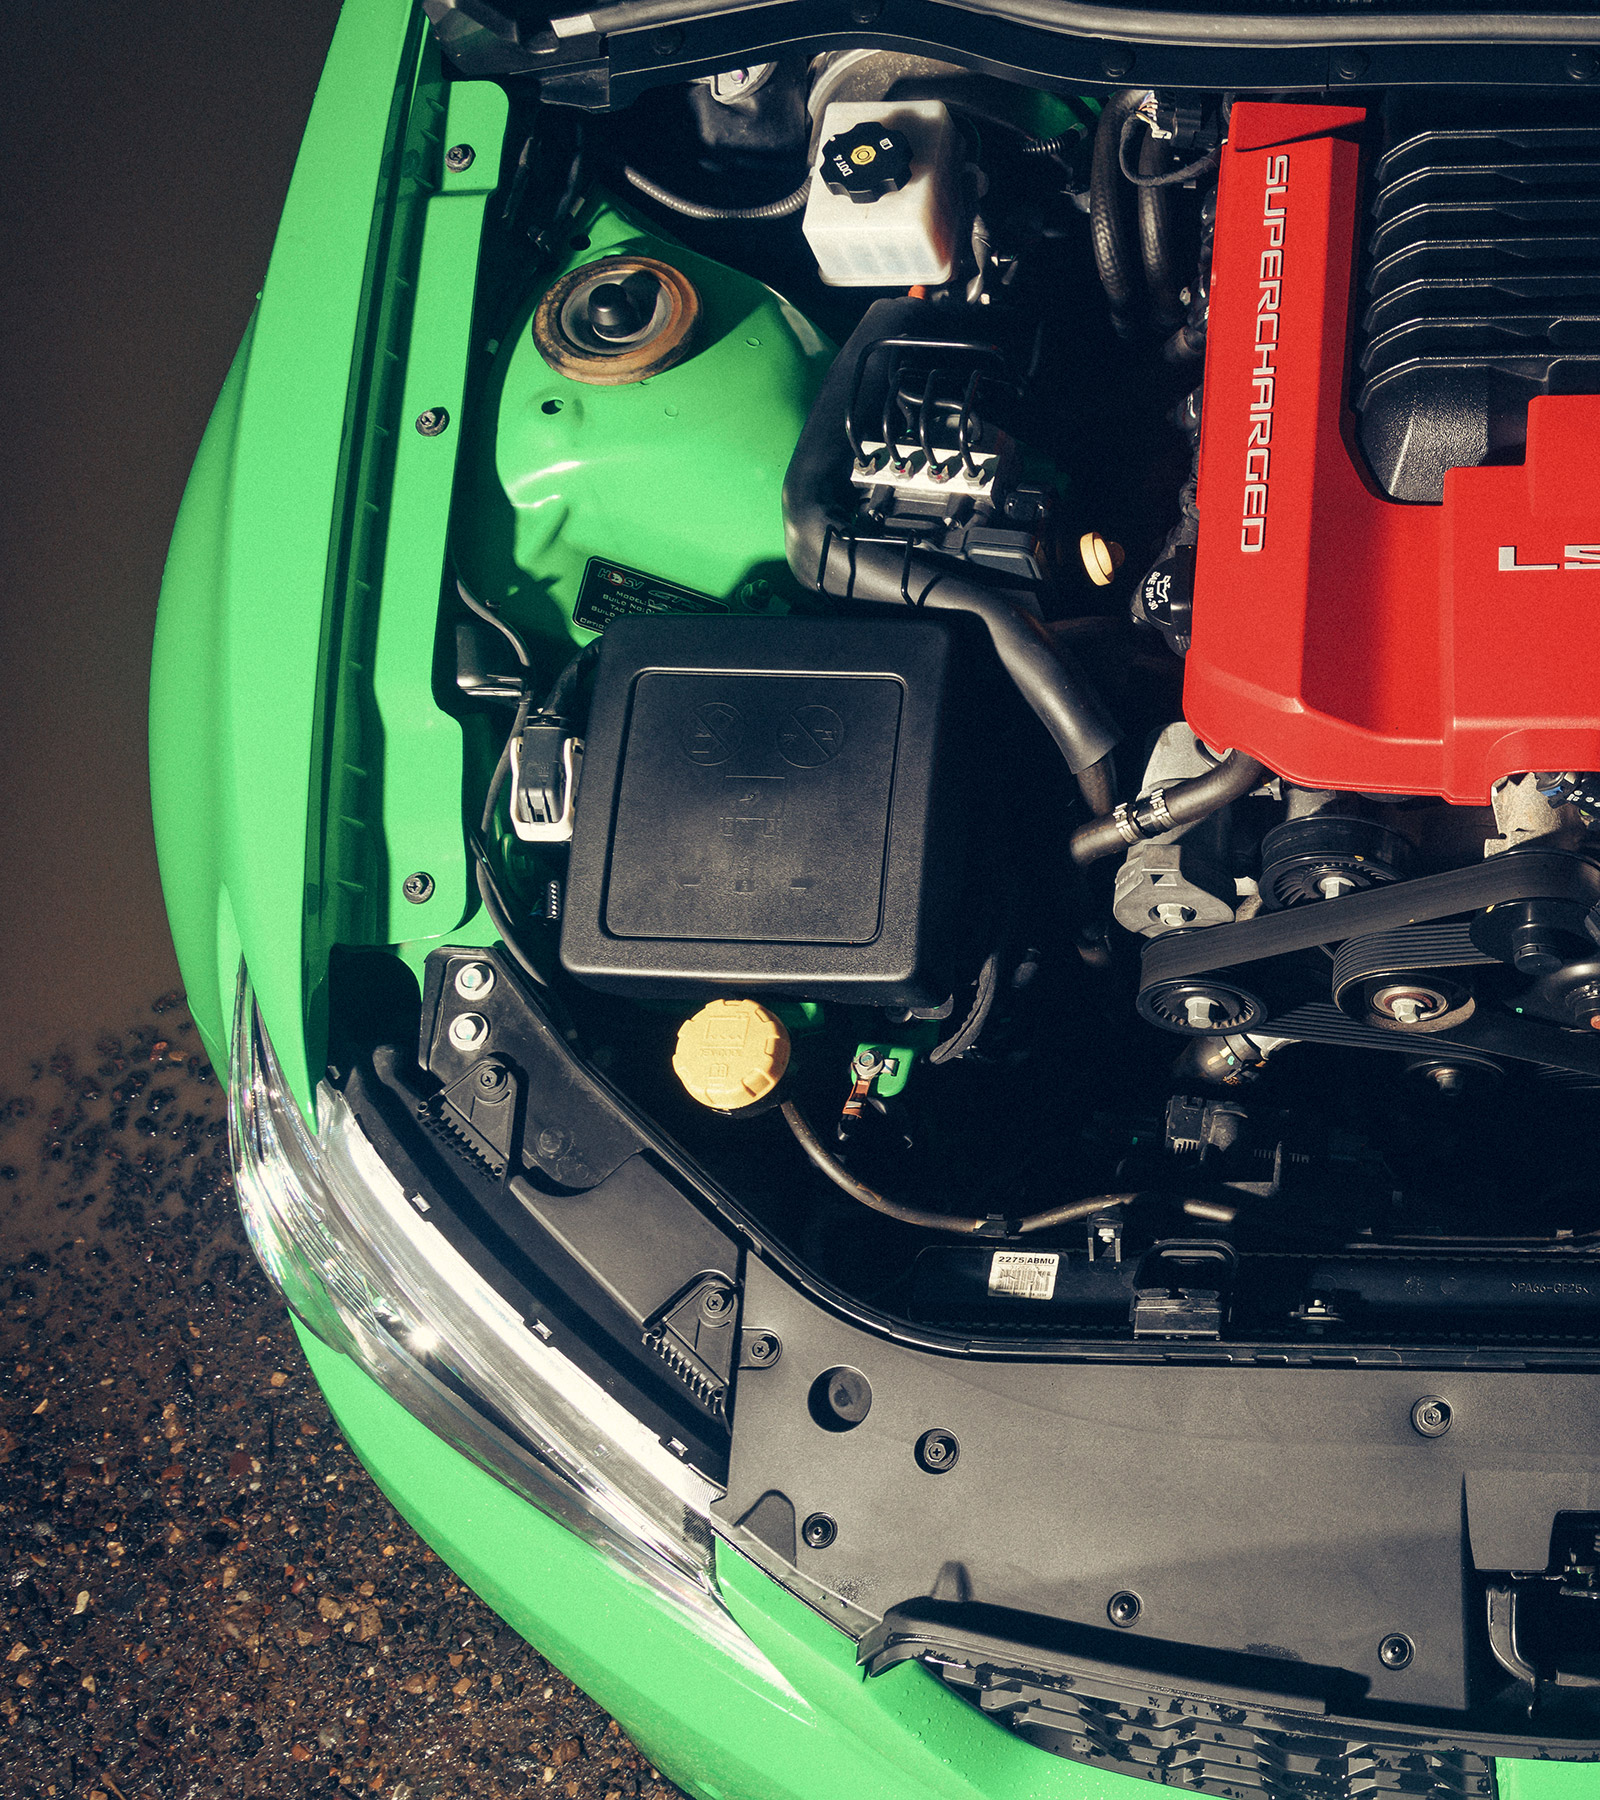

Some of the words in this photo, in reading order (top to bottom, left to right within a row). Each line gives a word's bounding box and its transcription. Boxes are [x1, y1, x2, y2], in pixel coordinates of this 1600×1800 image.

[833, 154, 843, 162] 4
[835, 160, 853, 177] DOT
[1241, 154, 1290, 553] SUPERCHARGED
[1147, 571, 1161, 586] SAE
[616, 591, 647, 606] MODEL:
[1145, 586, 1159, 611] 5W-30
[1027, 1257, 1055, 1265] ABMU
